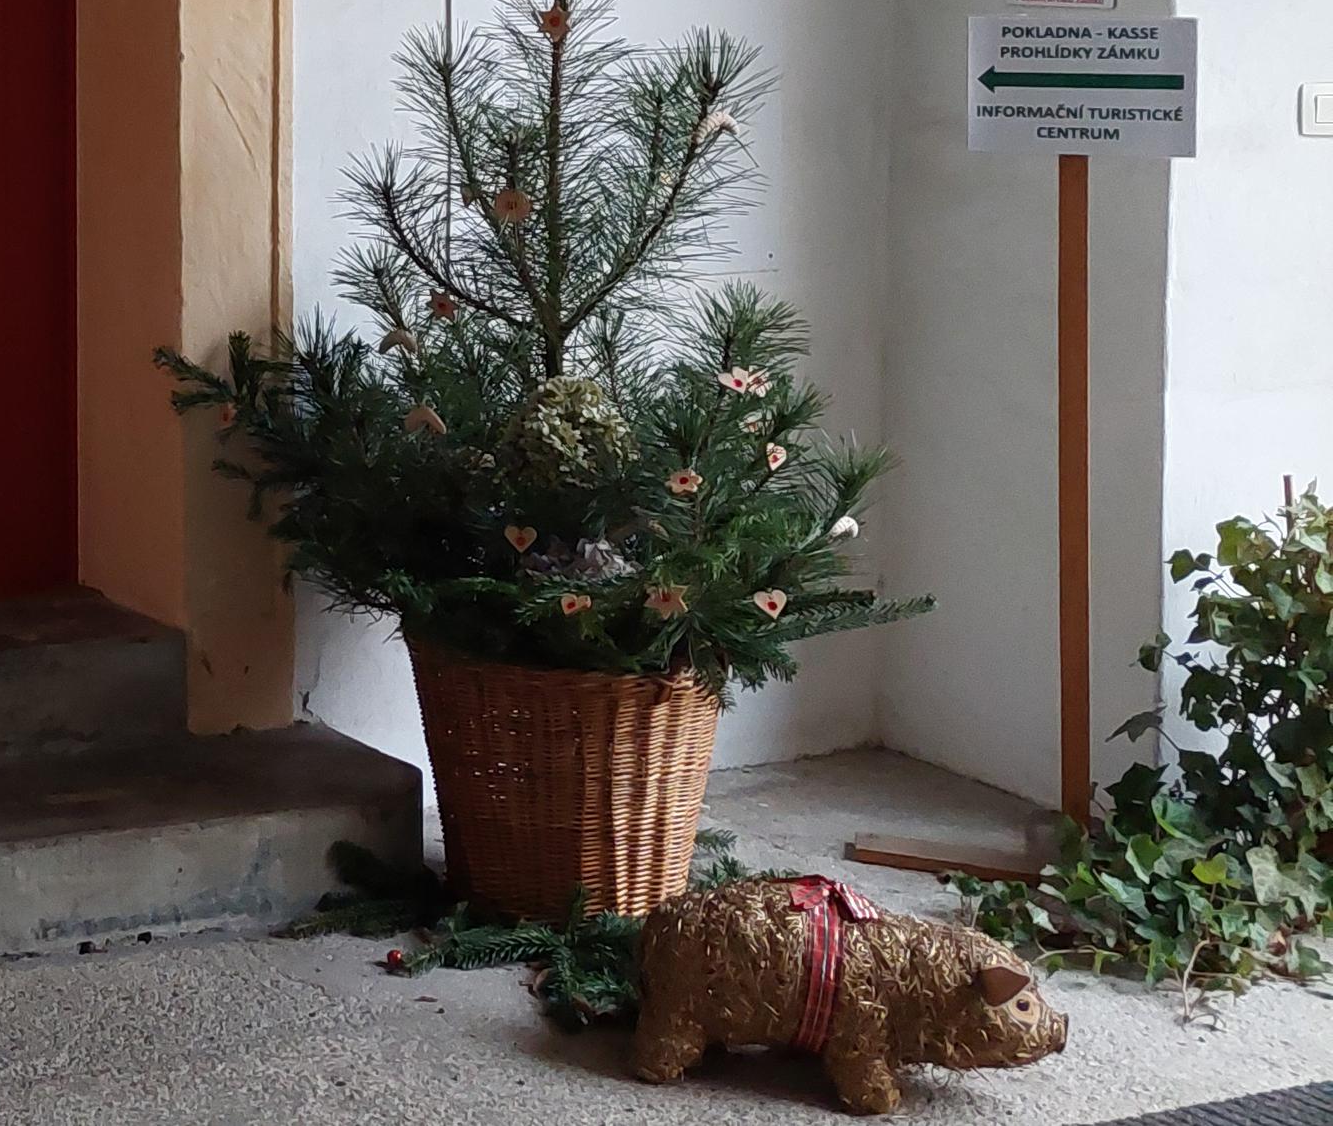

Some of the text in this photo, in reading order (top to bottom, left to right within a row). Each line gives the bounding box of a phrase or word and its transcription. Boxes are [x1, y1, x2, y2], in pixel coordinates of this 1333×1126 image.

[1001, 26, 1093, 40] POKLADNA
[1107, 27, 1160, 40] KASSE
[1000, 45, 1161, 61] PROHLÍDKY ZÁMKU
[976, 103, 1184, 123] INFORMAČNÍ TURISTICKÉ
[1036, 126, 1121, 141] CENTRUM
